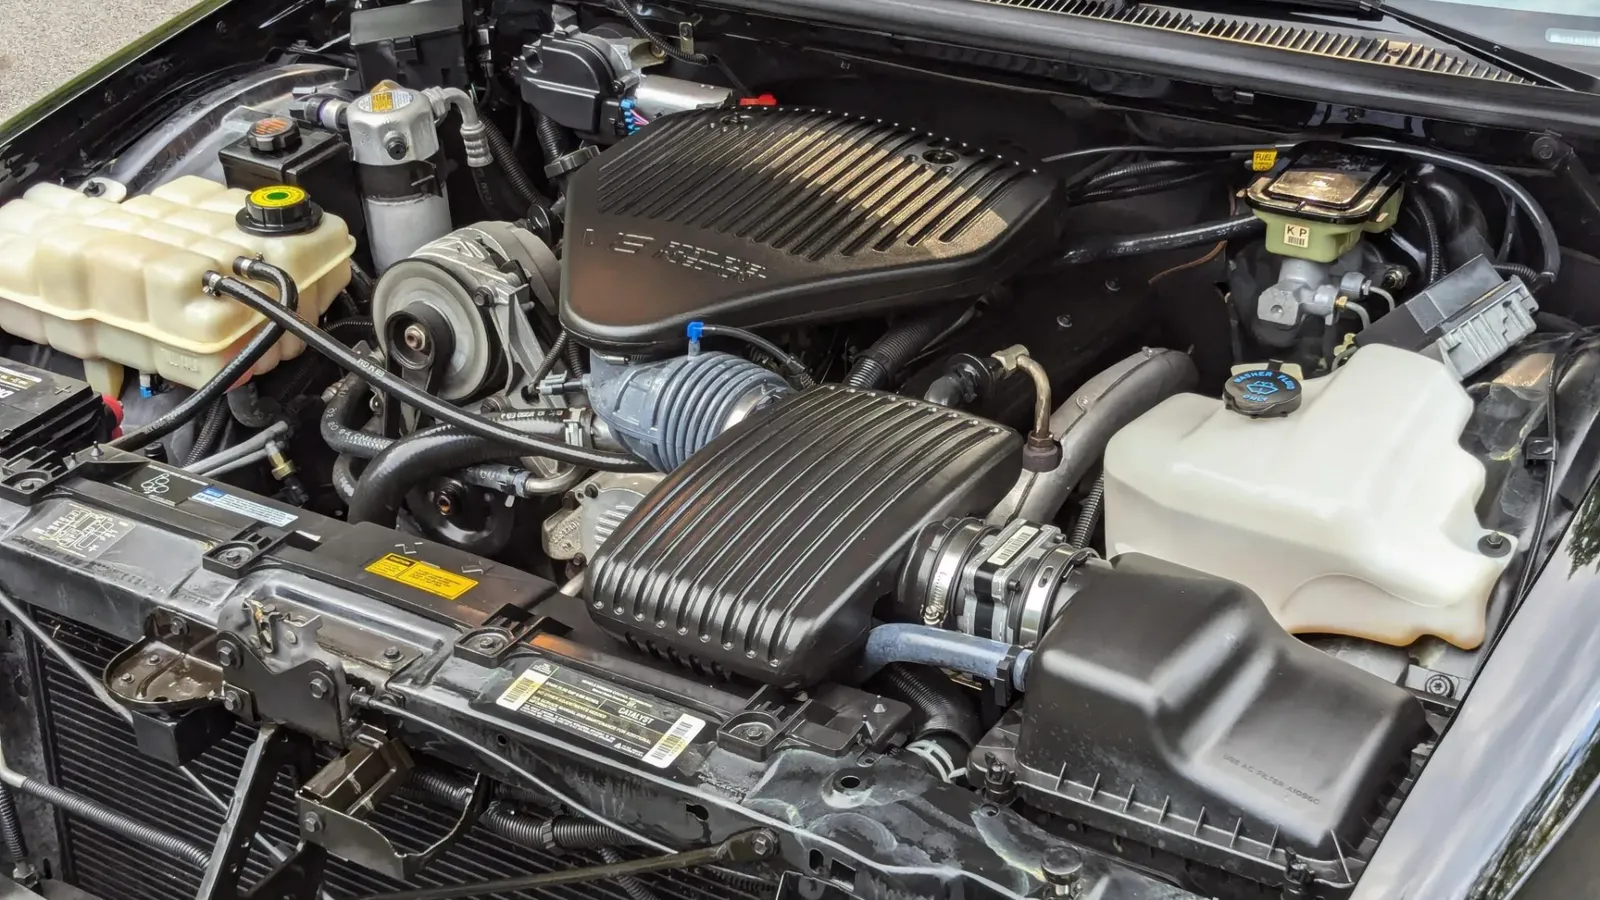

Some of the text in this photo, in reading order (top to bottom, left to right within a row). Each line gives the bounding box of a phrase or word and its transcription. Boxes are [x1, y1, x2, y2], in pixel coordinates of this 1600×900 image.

[1255, 153, 1273, 161] FUEL
[1286, 225, 1307, 237] K P
[1233, 371, 1296, 390] WASHER FLUID
[1242, 394, 1268, 403] ONLY
[617, 706, 655, 725] CATALYST
[1256, 770, 1284, 787] FILTER
